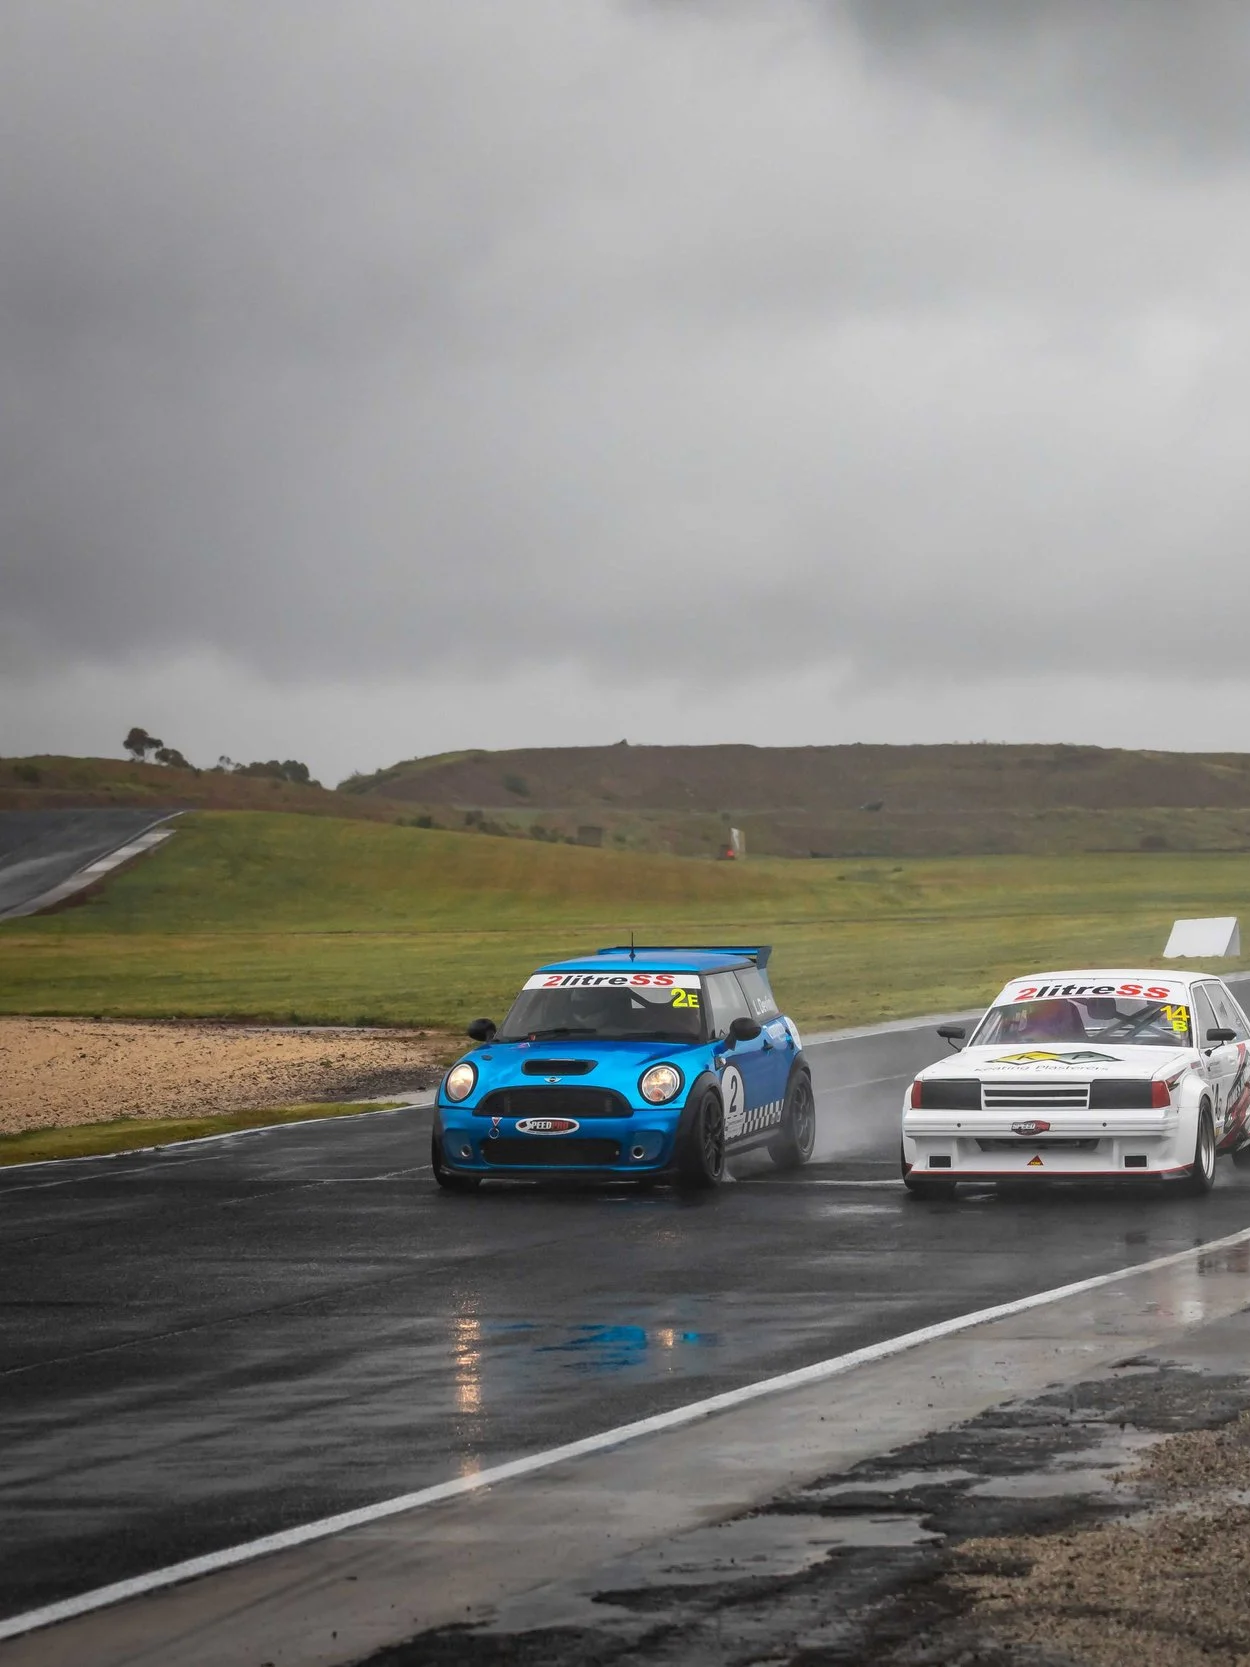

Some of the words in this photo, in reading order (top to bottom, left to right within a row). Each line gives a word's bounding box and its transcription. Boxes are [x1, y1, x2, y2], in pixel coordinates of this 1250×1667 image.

[542, 974, 675, 987] 2litreSS
[1014, 984, 1171, 1000] 2litreSS
[1160, 1005, 1190, 1021] 14
[1172, 1020, 1188, 1032] B
[729, 1074, 738, 1113] 2
